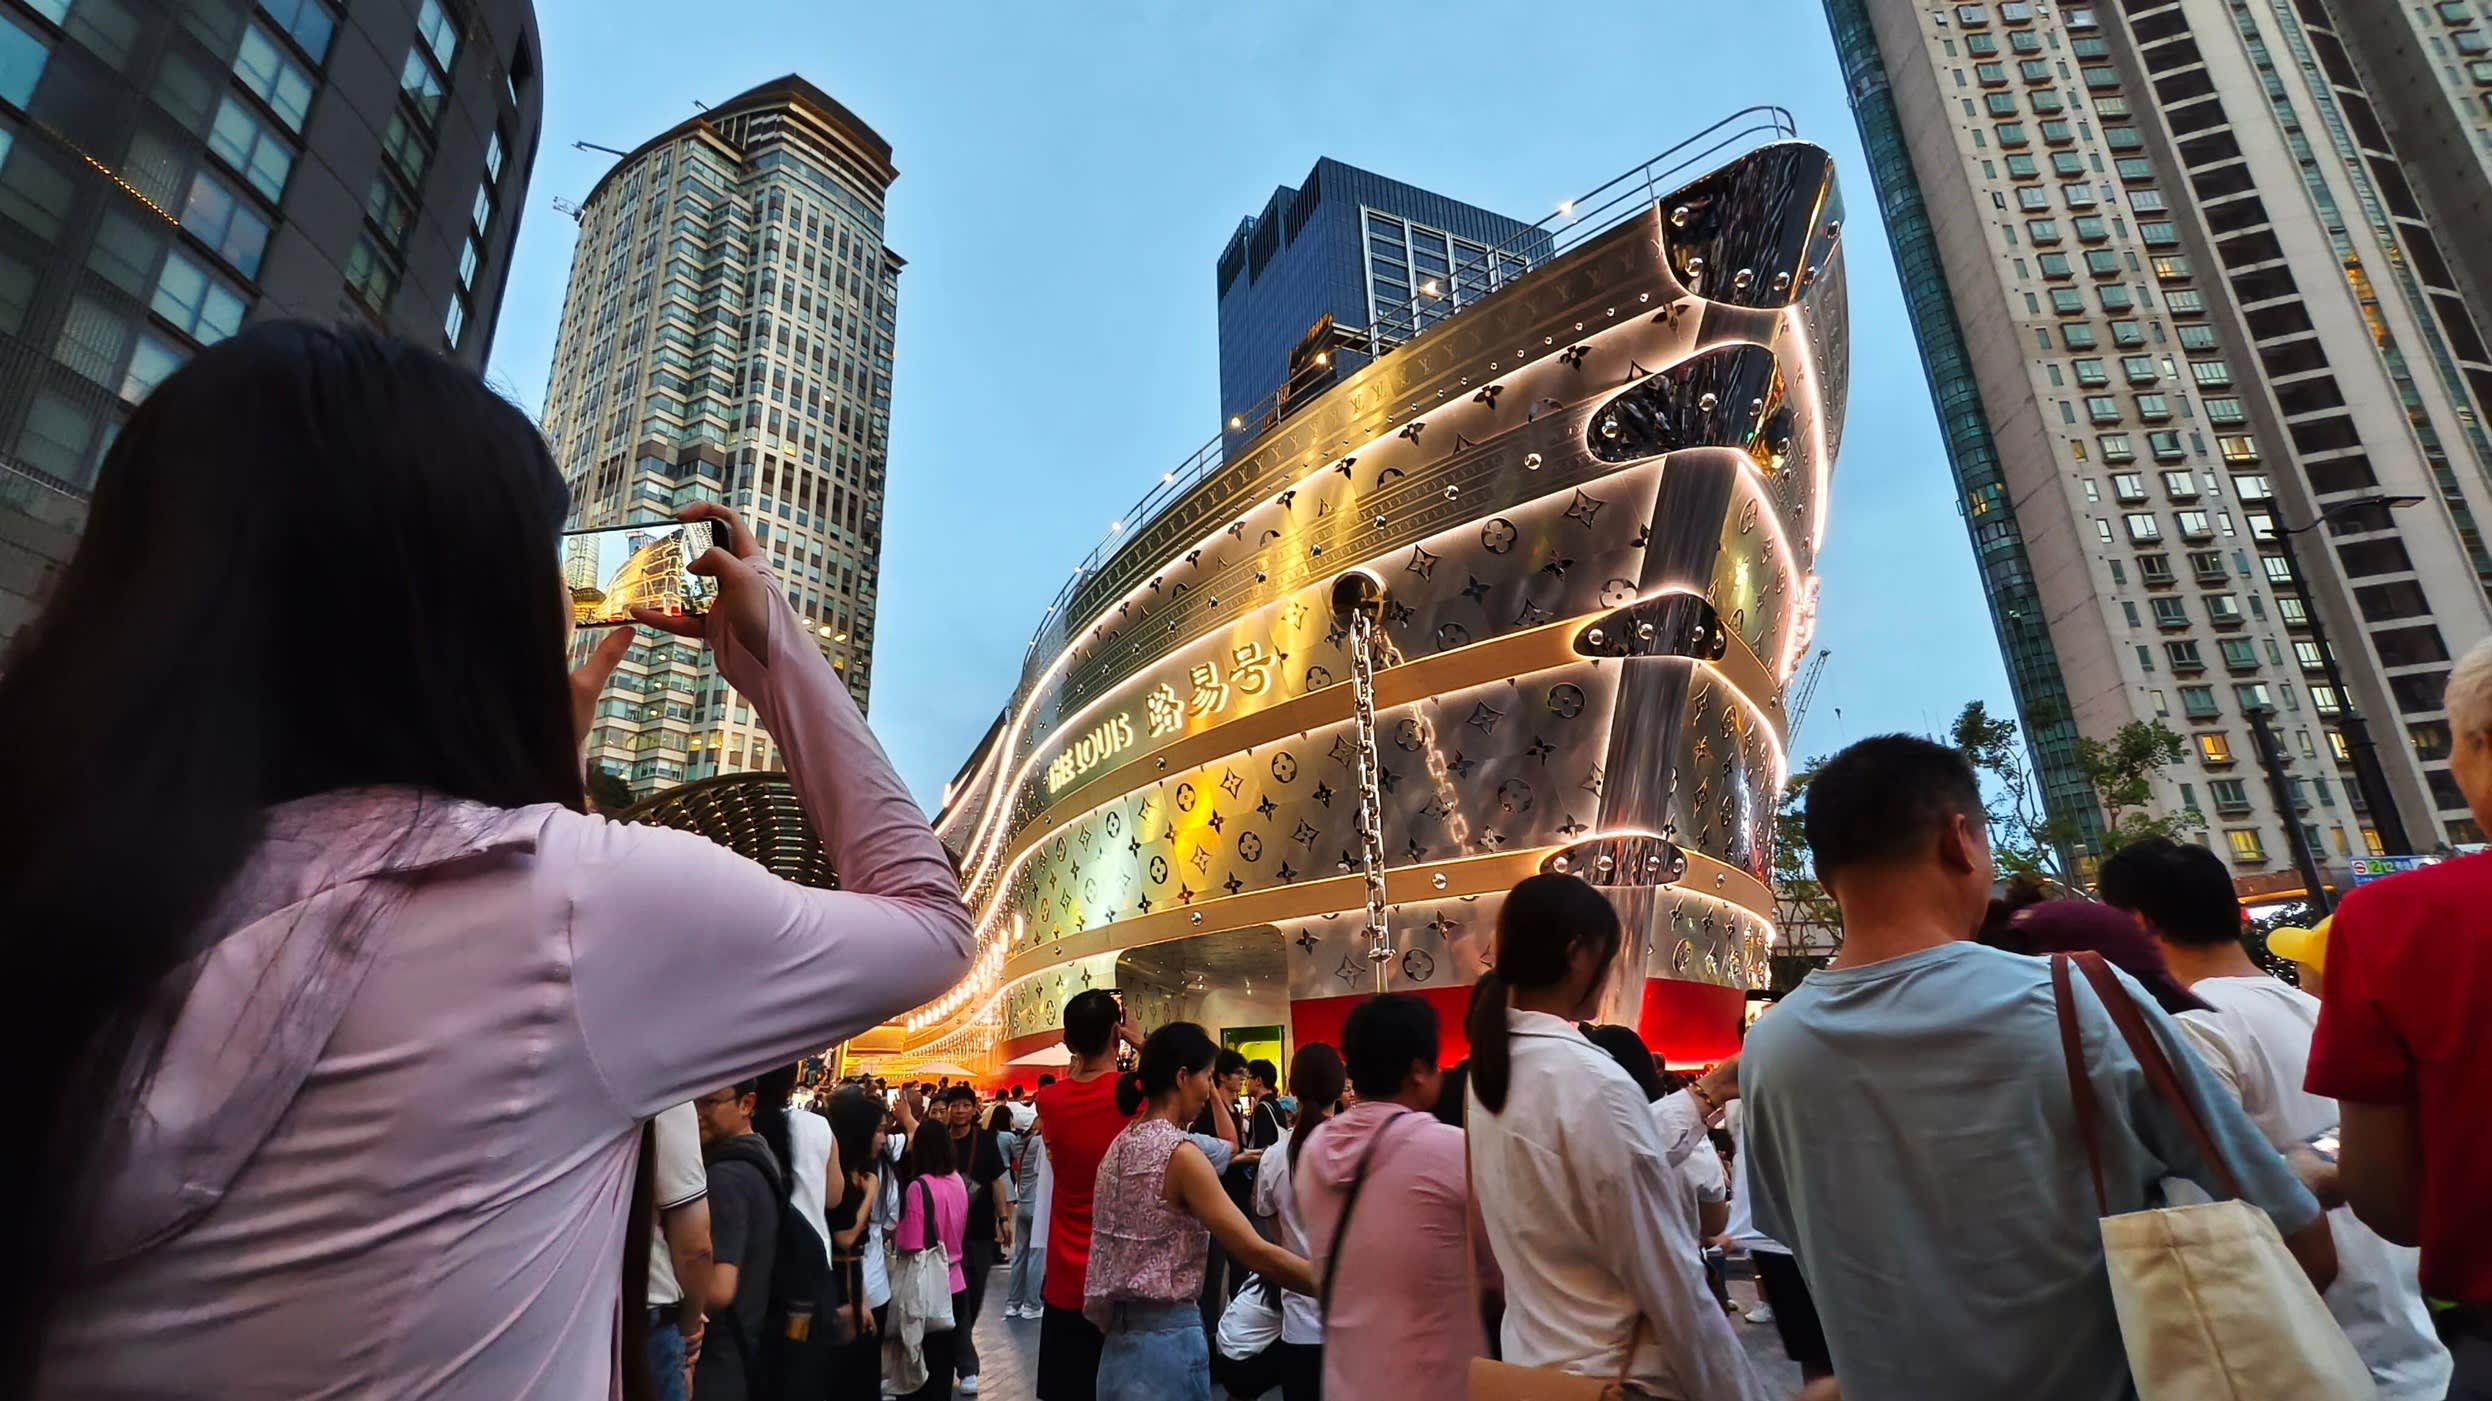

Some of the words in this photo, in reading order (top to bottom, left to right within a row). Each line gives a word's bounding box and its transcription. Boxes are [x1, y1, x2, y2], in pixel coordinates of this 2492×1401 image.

[1145, 640, 1278, 738] 路易号
[1074, 712, 1134, 775] LOUIS
